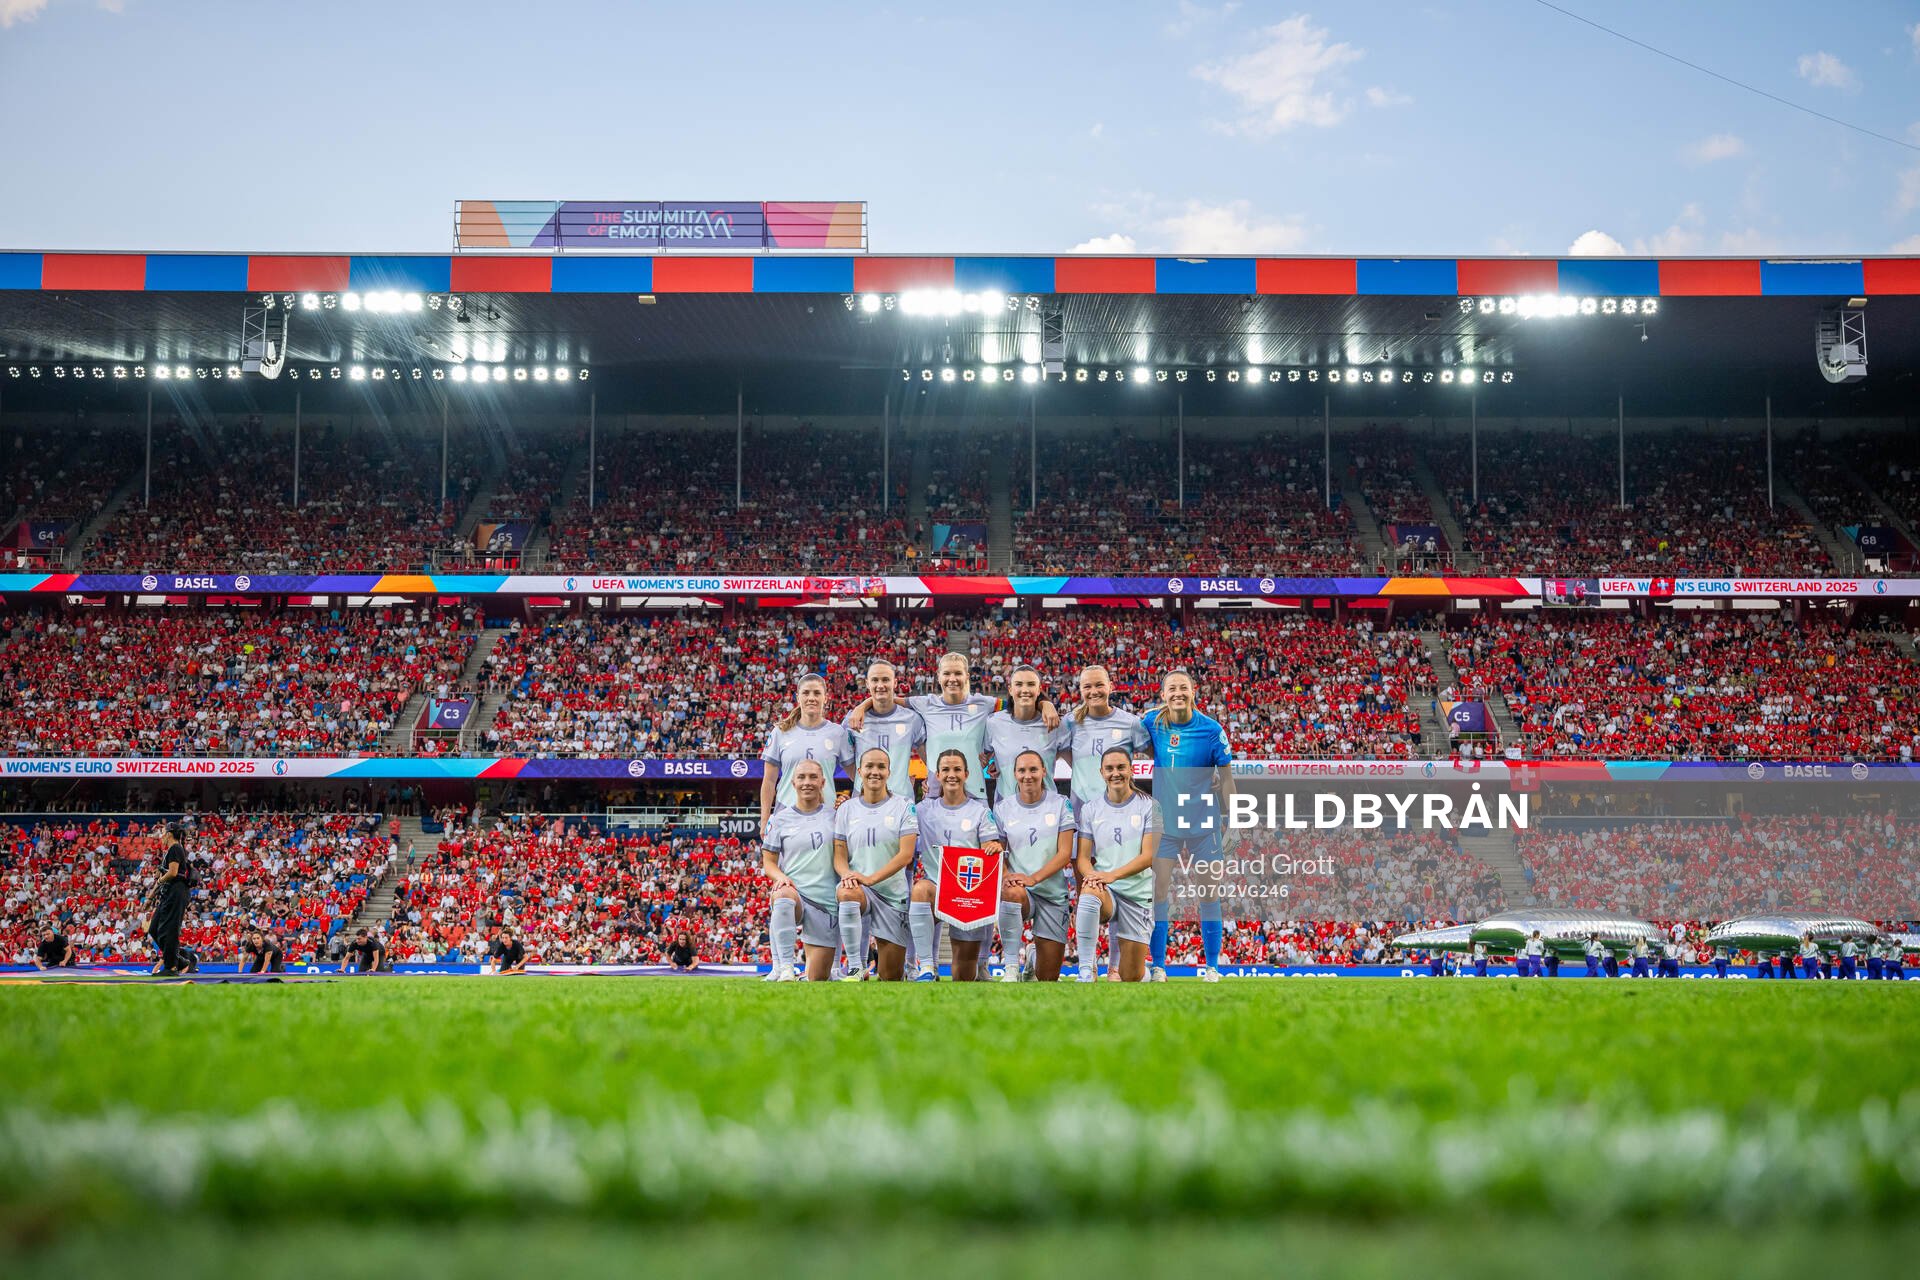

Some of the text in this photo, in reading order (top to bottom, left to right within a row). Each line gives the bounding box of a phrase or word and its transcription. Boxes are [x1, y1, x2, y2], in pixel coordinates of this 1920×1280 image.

[593, 209, 697, 224] THE SUMMIT
[587, 225, 705, 239] OF EMOTIONS
[38, 530, 54, 540] G4
[497, 532, 513, 542] G5
[1861, 535, 1877, 545] G8
[174, 577, 218, 589] BASEL
[592, 579, 625, 590] UEFA
[627, 579, 684, 590] WOMEN'S
[687, 579, 720, 590] EURO
[723, 579, 811, 590] SWITZERLAND
[1200, 580, 1243, 592] BASEL
[1602, 581, 1636, 592] UEFA
[1698, 581, 1731, 592] EURO
[1733, 581, 1823, 592] SWITZERLAND
[1825, 581, 1858, 592] 2025
[443, 708, 460, 719] C3
[1454, 711, 1471, 722] C5
[951, 713, 962, 731] 14
[6, 761, 71, 774] WOMEN'S
[75, 761, 113, 774] EURO
[116, 761, 216, 774] SWITZERLAND
[219, 761, 255, 774] 2025
[664, 762, 712, 775] BASEL
[1231, 763, 1264, 776] EURO
[1267, 763, 1365, 776] SWITZERLAND
[1369, 763, 1404, 776] 2025
[1784, 765, 1832, 778] BASEL
[720, 820, 755, 833] SMD
[810, 831, 823, 850] 13
[867, 828, 876, 847] 11
[1113, 827, 1122, 846] 8
